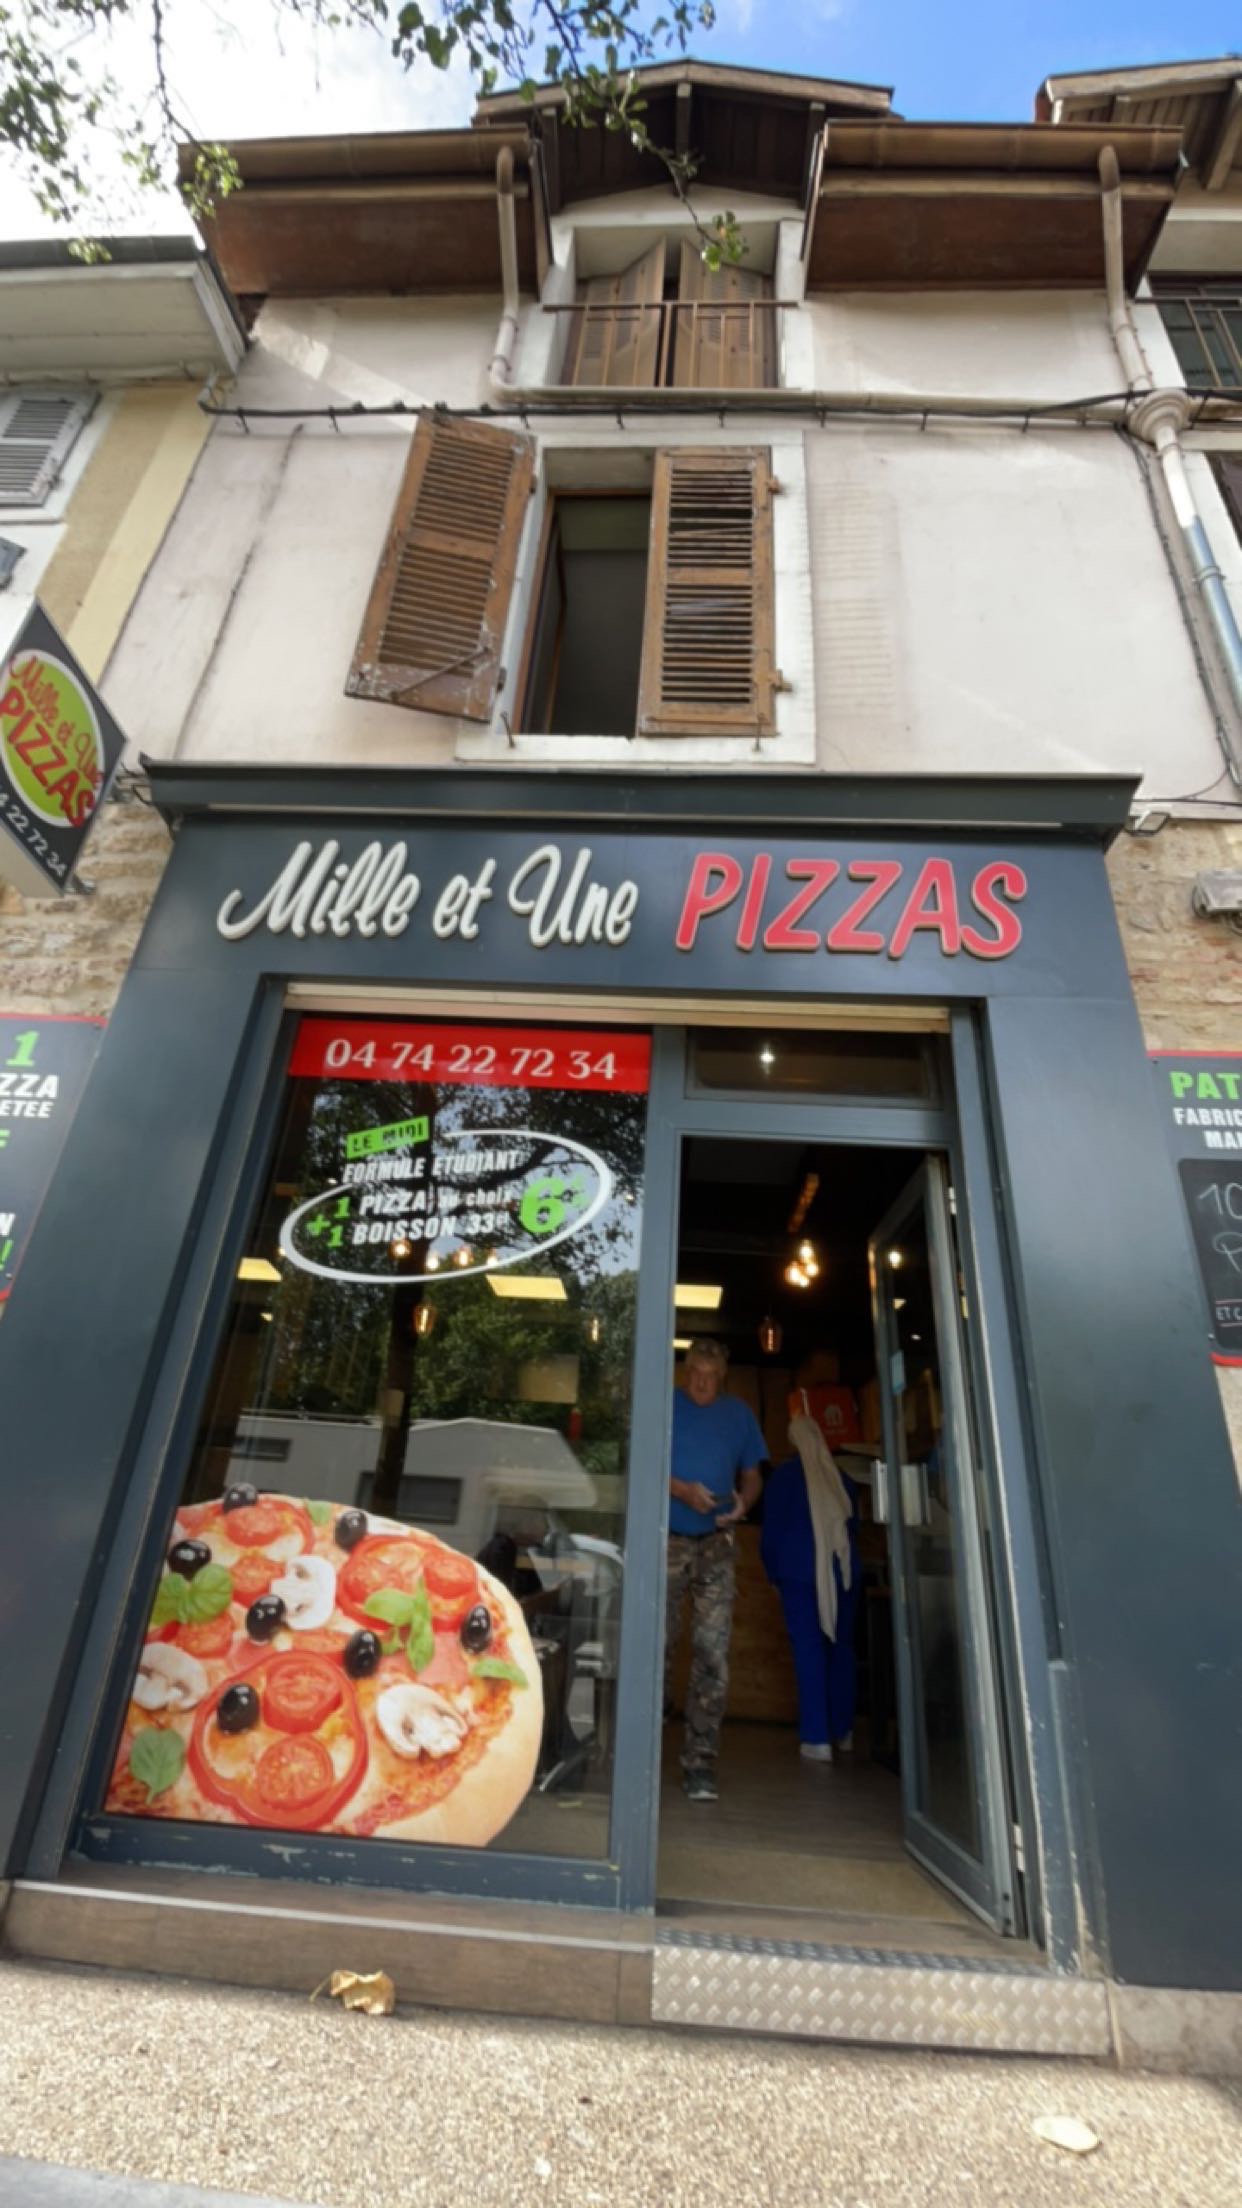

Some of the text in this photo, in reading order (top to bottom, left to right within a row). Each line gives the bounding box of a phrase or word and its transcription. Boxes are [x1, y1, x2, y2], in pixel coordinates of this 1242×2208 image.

[9, 655, 105, 791] Mille et Une
[0, 686, 95, 829] PIZZAS
[6, 804, 29, 834] 22
[27, 828, 48, 856] 72
[46, 851, 67, 877] 34
[217, 840, 1027, 960] Mille et Une PIZZAS
[6, 1030, 40, 1067] 1
[324, 1038, 618, 1081] 04 74 22 72 34
[353, 1121, 425, 1152] LE MIDI
[342, 1149, 518, 1184] FORMULE ETUDIANT
[358, 1187, 426, 1216] PIZZA
[351, 1215, 457, 1246] BOISSON
